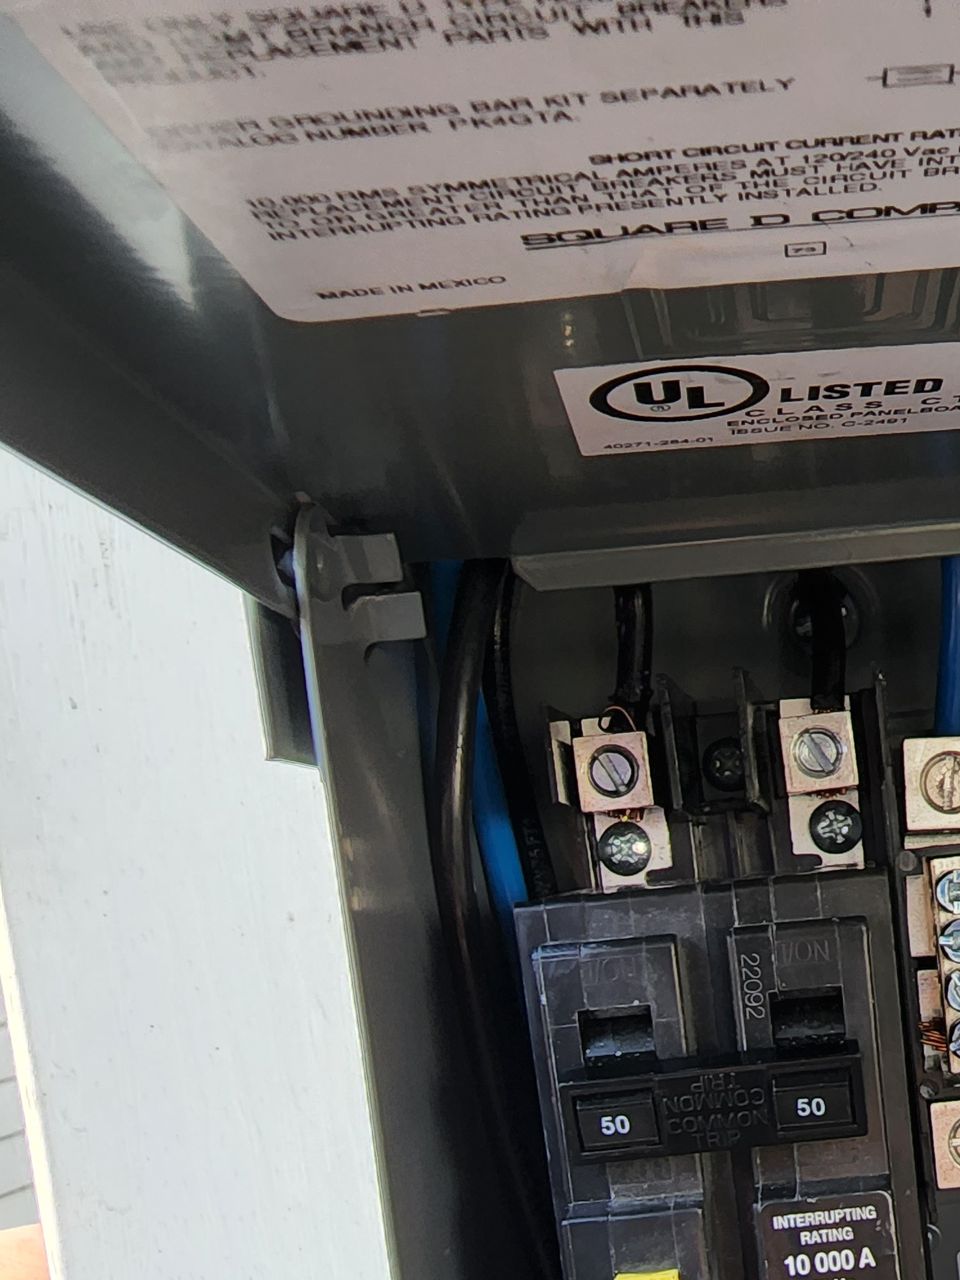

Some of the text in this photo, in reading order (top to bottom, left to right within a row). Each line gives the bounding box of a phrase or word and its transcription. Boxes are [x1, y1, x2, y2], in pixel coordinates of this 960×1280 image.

[269, 102, 460, 130] GROUNDING
[470, 96, 533, 115] BAR
[543, 92, 591, 109] KIT
[600, 77, 795, 105] SEPARATELY
[305, 120, 431, 143] NUMBER
[589, 148, 676, 165] SHORT
[682, 140, 779, 158] CIRCUIT
[785, 132, 904, 150] CURRENT
[336, 187, 398, 202] RMS
[407, 170, 608, 196] SYMMETRICAL
[615, 158, 747, 178] AMPERES
[756, 155, 793, 168] AT
[803, 149, 897, 165] 120/240
[904, 146, 950, 157] Vac
[250, 196, 455, 221] REPLACEMENT
[470, 183, 578, 202] CIRCUIT
[592, 172, 737, 193] BREAKERS
[750, 164, 826, 178] MUST
[837, 158, 907, 172] HAVE
[265, 219, 299, 230] TO
[312, 214, 356, 228] OR
[365, 202, 502, 223] GREATER
[520, 194, 589, 208] THAN
[604, 187, 674, 201] THAT
[686, 183, 725, 194] OF
[739, 178, 790, 191] THE
[804, 169, 913, 186] CIRCUIT
[268, 182, 883, 242] INTERRUPTING RATING PRESENTLY INSTALLED.
[520, 218, 729, 246] SQUARE
[750, 213, 791, 227] D
[316, 275, 507, 301] MADE IN MEXICO
[633, 379, 725, 410] UL
[780, 377, 945, 403] LISTED
[727, 412, 844, 428] ENCLOSED
[745, 400, 884, 418] CLASS
[730, 421, 835, 436] ISSUE NO.
[741, 952, 766, 1021] 22092
[796, 1096, 827, 1118] 50
[600, 1114, 631, 1137] 50
[667, 1108, 769, 1135] COMMON
[691, 1129, 742, 1150] TRIP
[772, 1206, 878, 1231] INTERRUPTING
[799, 1227, 855, 1247] RATING
[784, 1246, 877, 1277] 10 000 A
